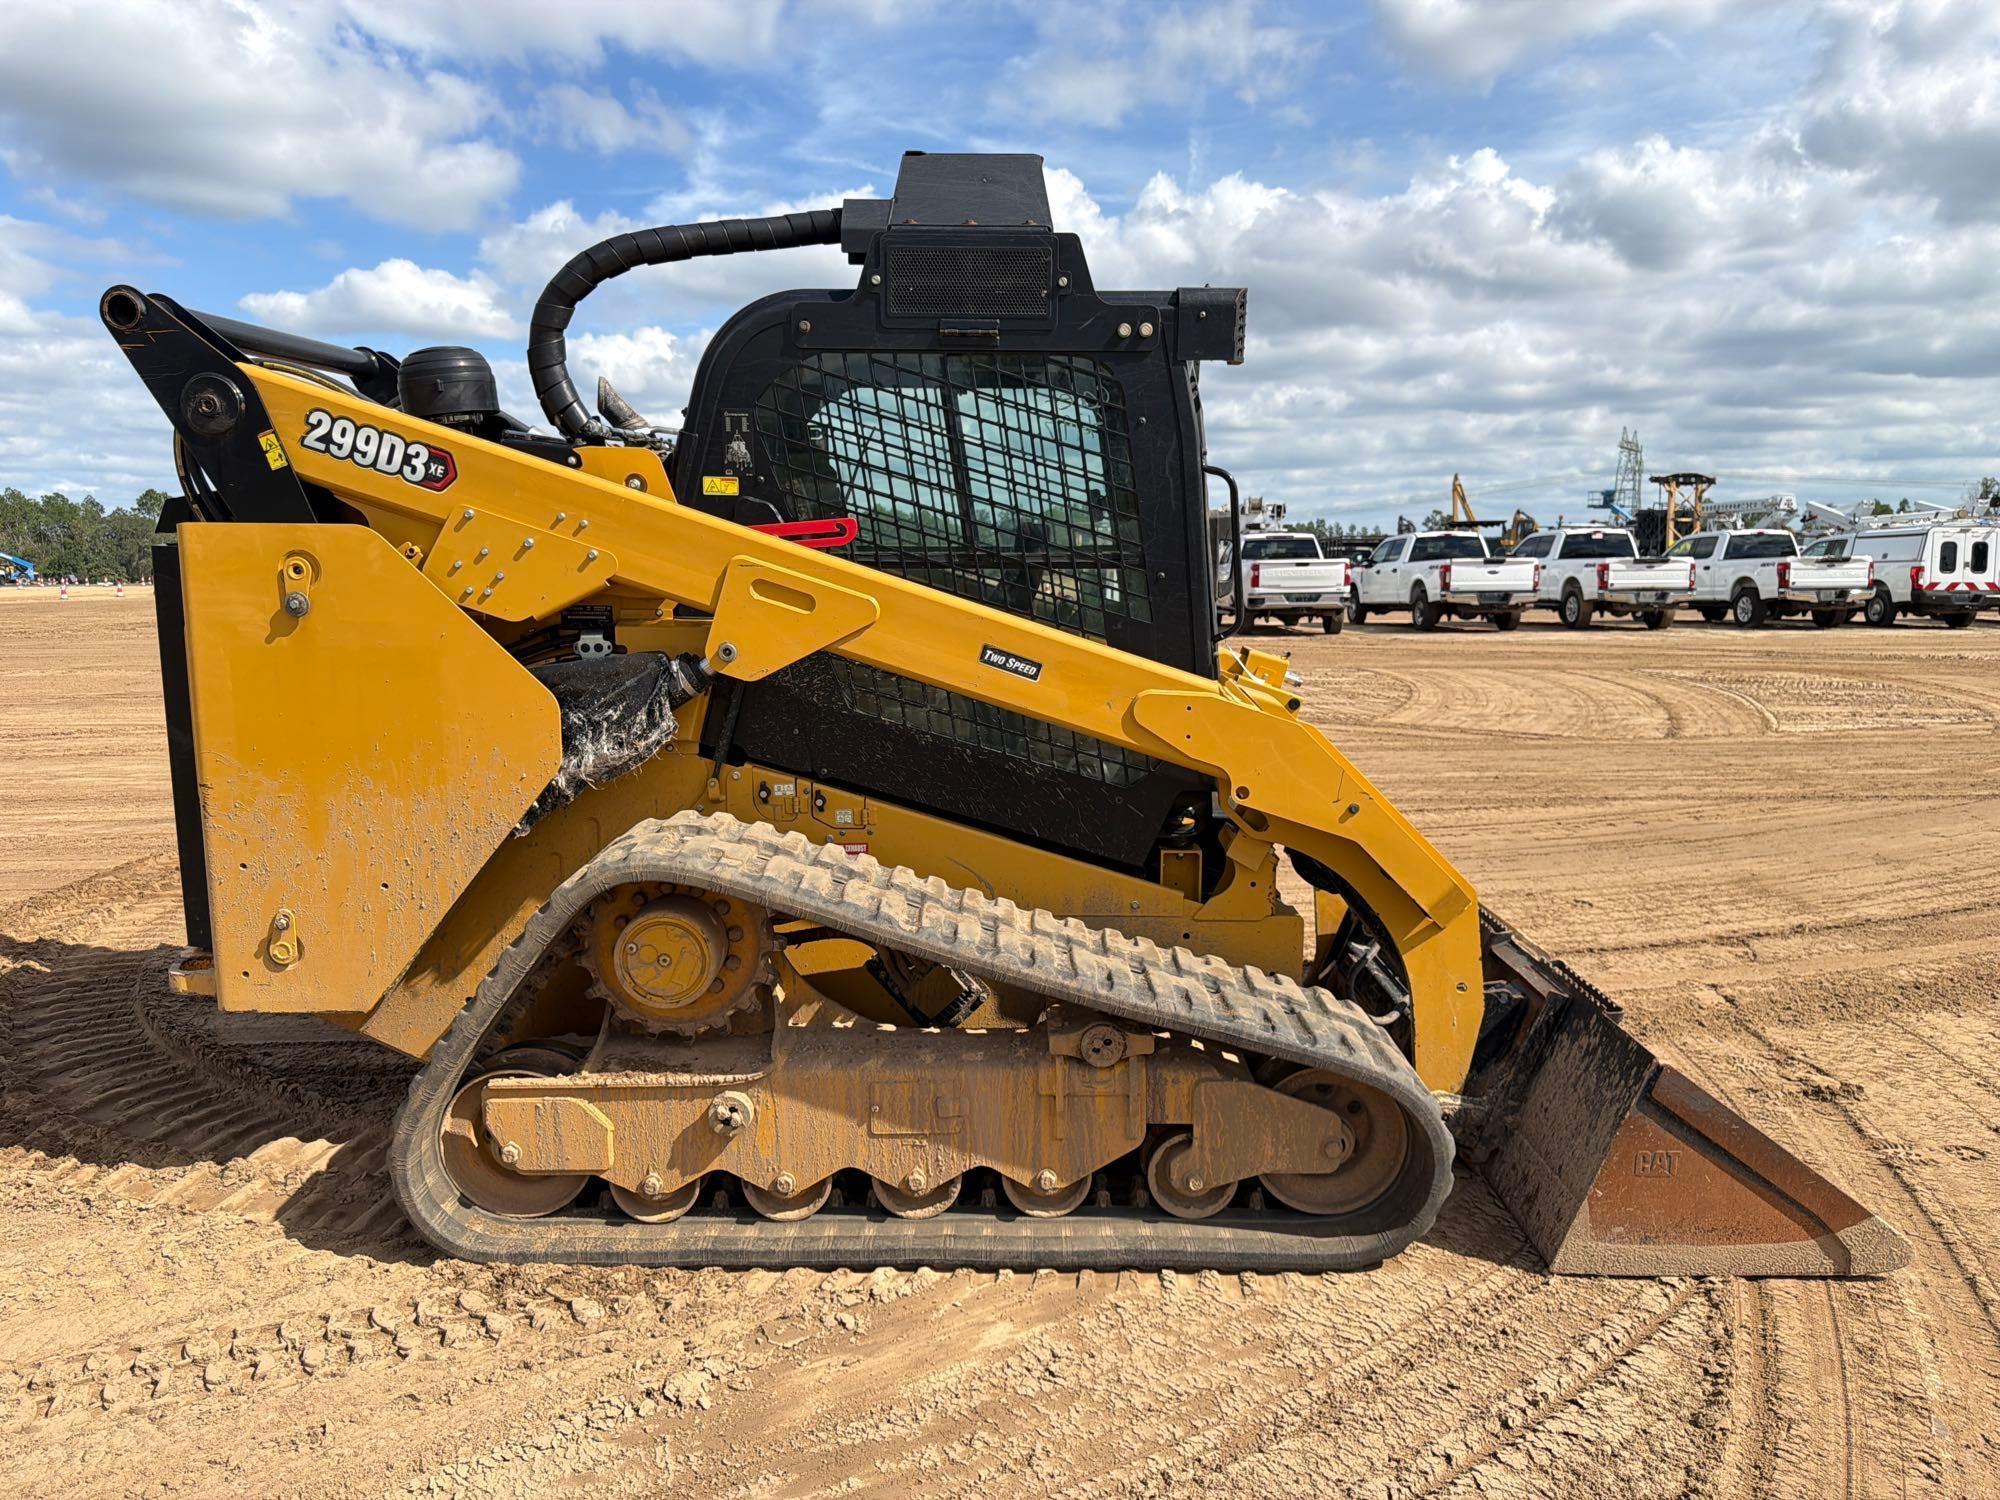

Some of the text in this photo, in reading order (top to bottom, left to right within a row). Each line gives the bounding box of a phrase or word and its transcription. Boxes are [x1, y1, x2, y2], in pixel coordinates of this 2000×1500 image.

[303, 411, 445, 482] 299D3 XE
[984, 650, 1037, 675] TWO SPEED
[1633, 1150, 1681, 1178] CAT
